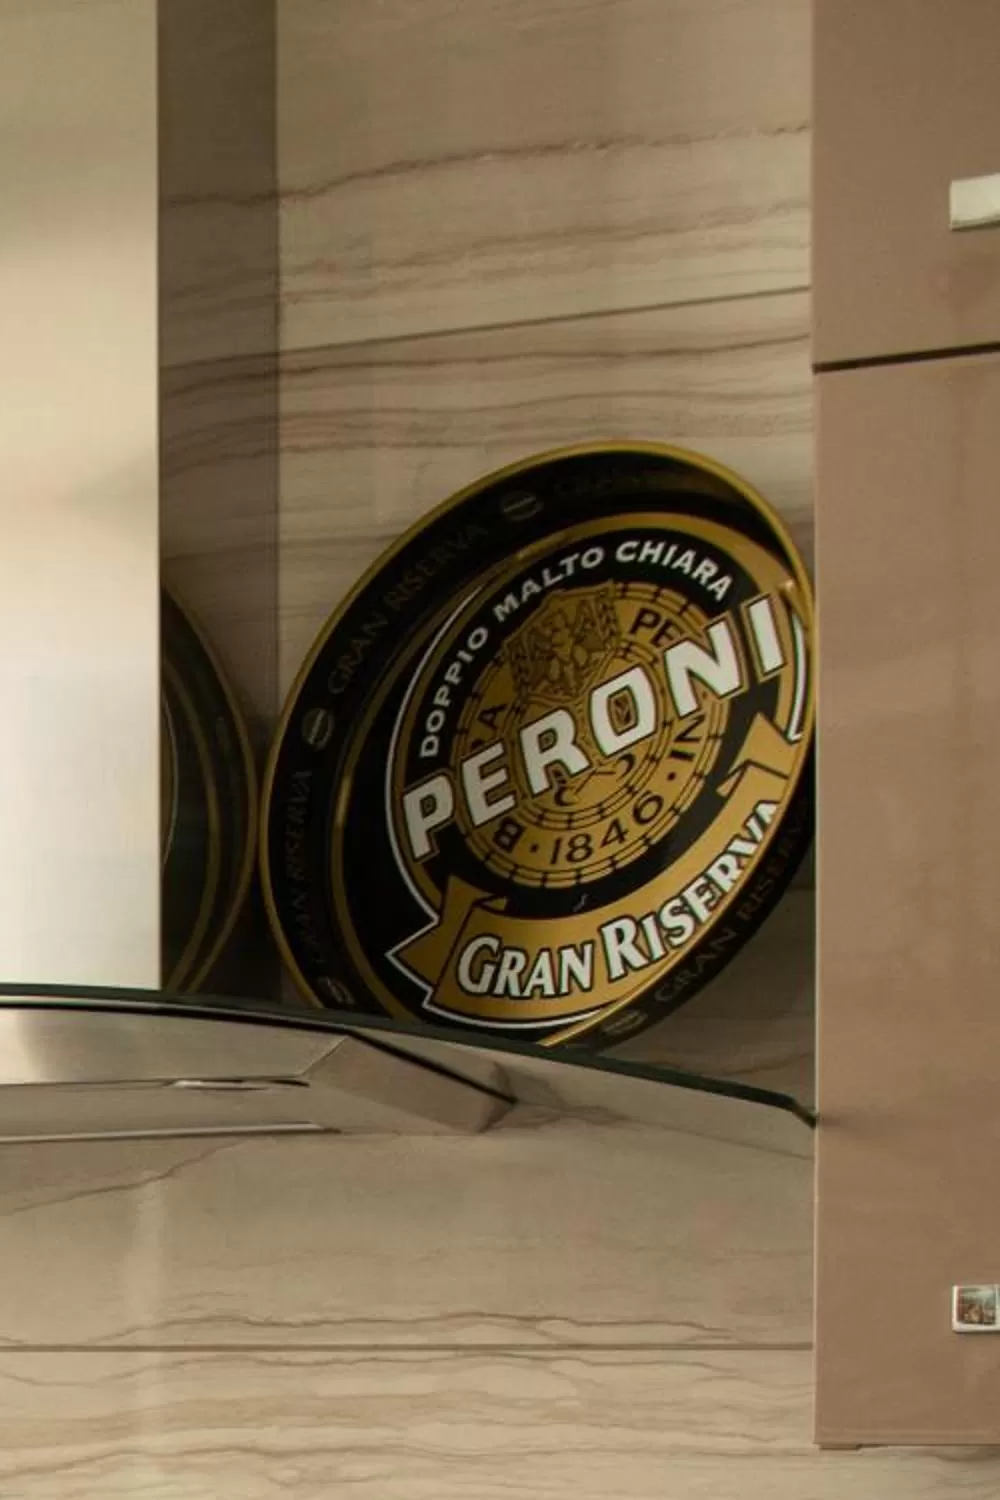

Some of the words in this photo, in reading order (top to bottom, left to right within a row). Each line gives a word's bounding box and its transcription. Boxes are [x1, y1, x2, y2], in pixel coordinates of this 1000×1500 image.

[402, 597, 786, 860] PERONI
[420, 626, 489, 759] DOPPIO
[492, 546, 605, 622] MALTO
[615, 540, 735, 603] CHIARA
[456, 936, 595, 999] GRAN
[599, 801, 778, 982] RISERVA
[549, 789, 664, 865] 1846
